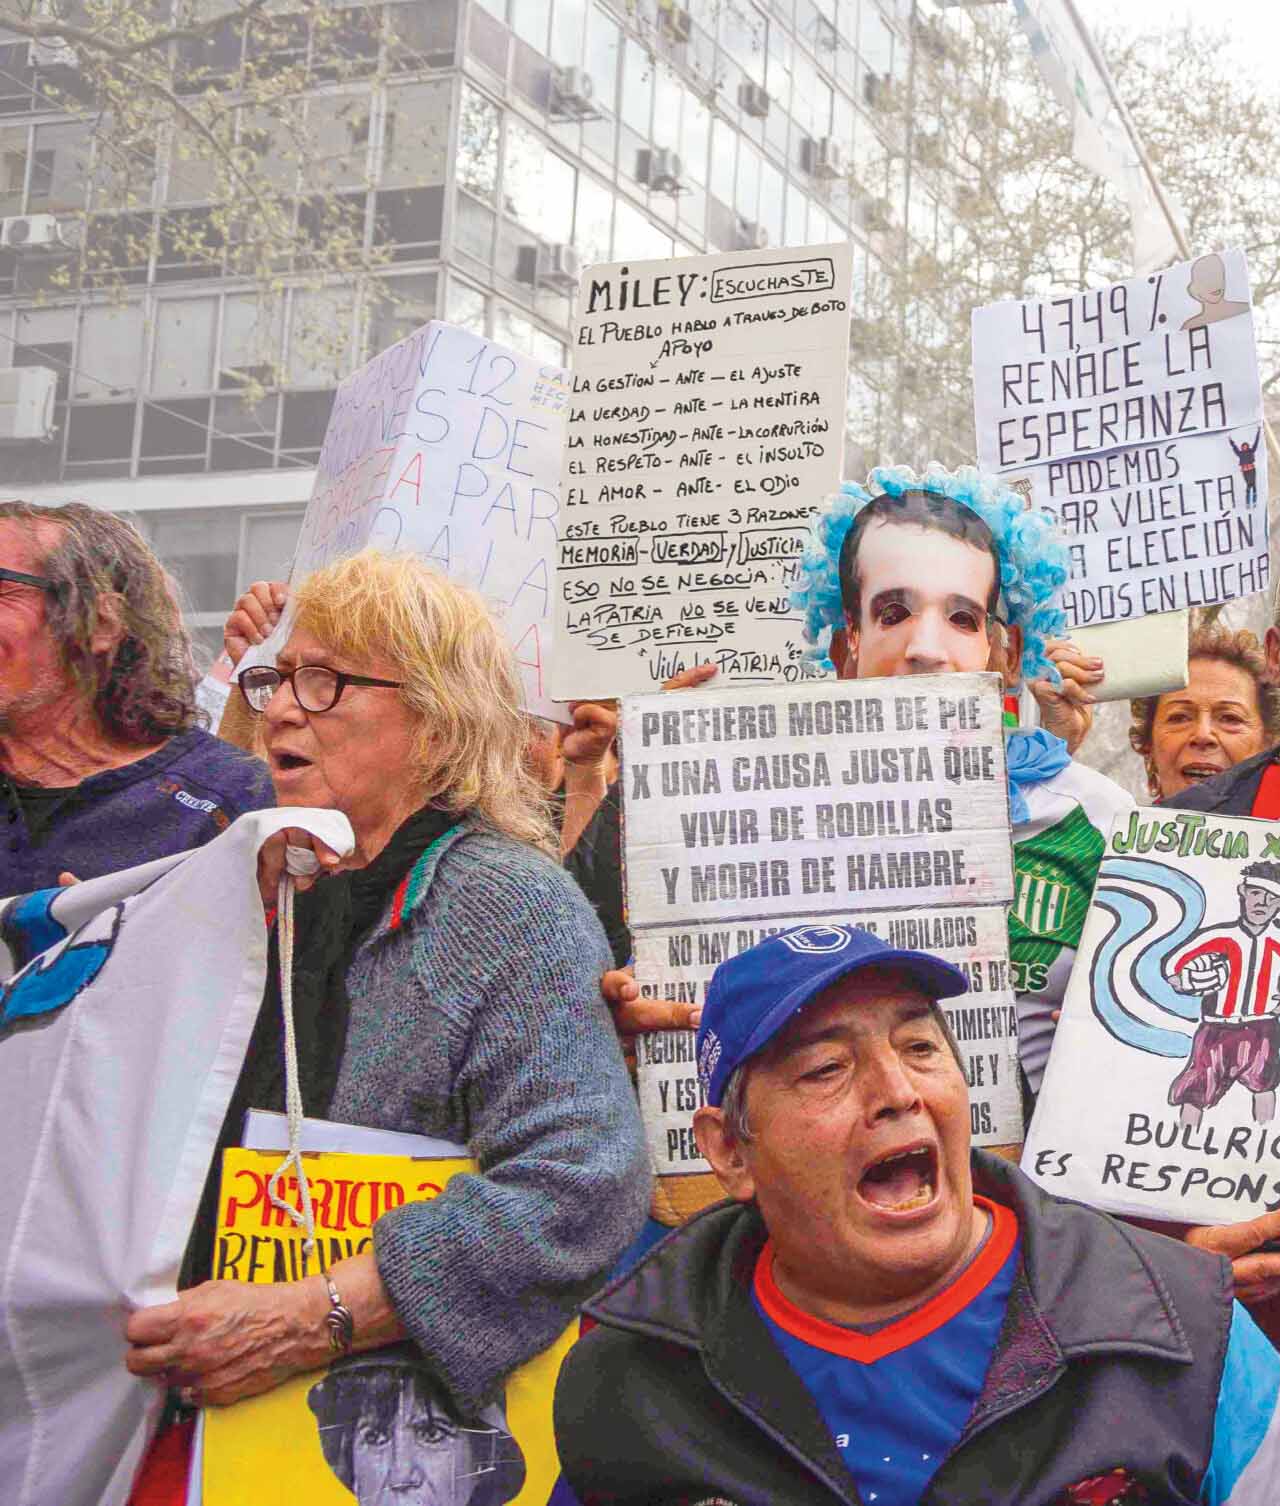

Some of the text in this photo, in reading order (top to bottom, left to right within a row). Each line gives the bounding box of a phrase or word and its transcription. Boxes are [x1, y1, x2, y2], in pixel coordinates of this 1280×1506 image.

[714, 268, 829, 299] ESCUCHASTE
[1147, 274, 1168, 332] %
[578, 326, 595, 345] EL
[600, 320, 662, 343] PUEBLO
[671, 318, 717, 336] HABLO
[722, 317, 732, 328] A
[734, 308, 787, 326] TRAVES
[811, 299, 847, 318] BOTO
[458, 345, 516, 406] 12
[572, 375, 591, 392] LA
[675, 370, 705, 385] ANTE
[729, 369, 746, 381] EL
[751, 364, 802, 384] AJUSTE
[1001, 324, 1214, 409] RENACE LA
[568, 406, 586, 423] LA
[593, 405, 650, 422] VERDAD
[673, 398, 708, 415] ANTE
[730, 398, 749, 410] LA
[998, 382, 1227, 467] ESPERANZA
[567, 435, 585, 448] LA
[691, 424, 725, 443] ANTE
[568, 460, 587, 474] EL
[679, 449, 714, 468] ANTE
[736, 451, 753, 466] EL
[1048, 444, 1180, 497] PODEMOS
[567, 487, 590, 507] EL
[598, 483, 648, 502] AMOR
[733, 478, 757, 494] EL
[1111, 475, 1236, 528] VUELTA
[566, 521, 602, 539] ESTE
[610, 513, 669, 533] PUEBLO
[727, 508, 743, 524] 3
[1107, 510, 1255, 573] ELECCIÓN
[656, 540, 723, 563] VERDAD
[562, 579, 601, 601] ESO
[610, 577, 635, 595] NO
[641, 576, 670, 591] SE
[1141, 576, 1176, 615] EN
[1183, 552, 1270, 607] LUCHA
[567, 611, 591, 630] LA
[680, 603, 705, 622] NO
[713, 599, 739, 614] SE
[745, 598, 792, 614] VEND
[586, 628, 622, 647] SE
[641, 695, 982, 748] PREFIERO MORIR DE PIE
[631, 745, 995, 801] X UNA CAUSA JUSTA QUE
[680, 798, 954, 849] VIVIR DE RODILLAS
[660, 848, 977, 905] Y MORIR DE HAMBRE.
[668, 935, 692, 967] NO
[698, 931, 731, 964] HAY
[887, 916, 977, 951] JUBILADOS
[988, 959, 1008, 992] DE
[658, 1079, 670, 1114] Y
[988, 1053, 1000, 1086] Y
[1034, 1149, 1075, 1177] ES
